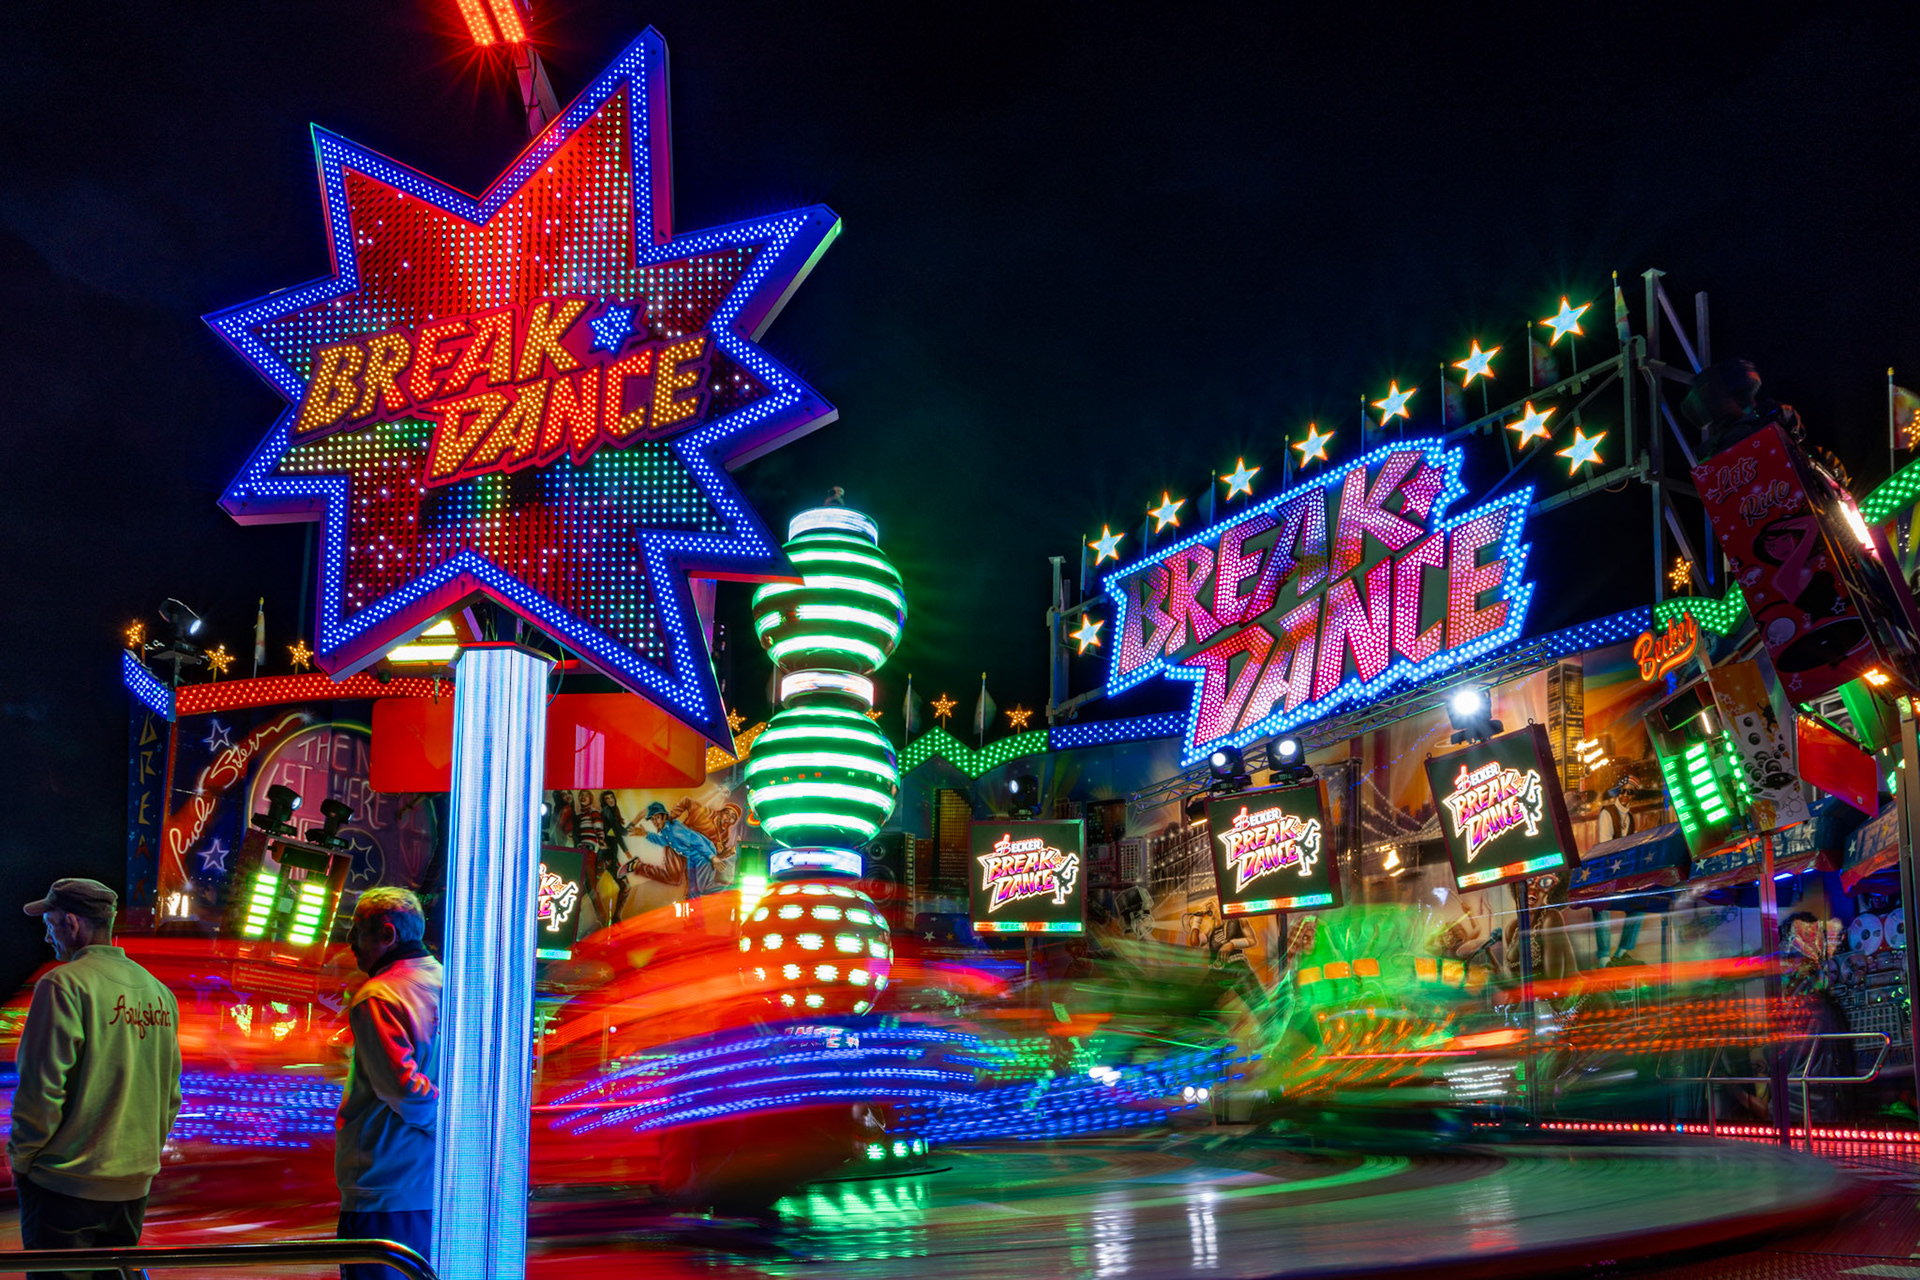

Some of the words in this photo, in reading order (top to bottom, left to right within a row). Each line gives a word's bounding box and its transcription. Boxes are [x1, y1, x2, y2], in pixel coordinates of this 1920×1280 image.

[295, 299, 589, 434] BREAK
[431, 336, 706, 480] DANCE
[1739, 479, 1791, 527] Ride
[1114, 449, 1430, 677] BREAK
[1181, 505, 1514, 747] DANCE
[1633, 611, 1697, 682] Becker
[1452, 773, 1518, 826] BREAK
[1454, 762, 1501, 792] BECKER
[1227, 818, 1297, 859] BREAK
[1232, 806, 1282, 830] BECKER
[1467, 796, 1523, 851] DANCE
[986, 849, 1056, 882] BREAK
[994, 833, 1044, 855] BECKER
[1239, 840, 1298, 882] DANCE
[995, 869, 1054, 904] DANCE
[109, 994, 171, 1039] Aufsicht
